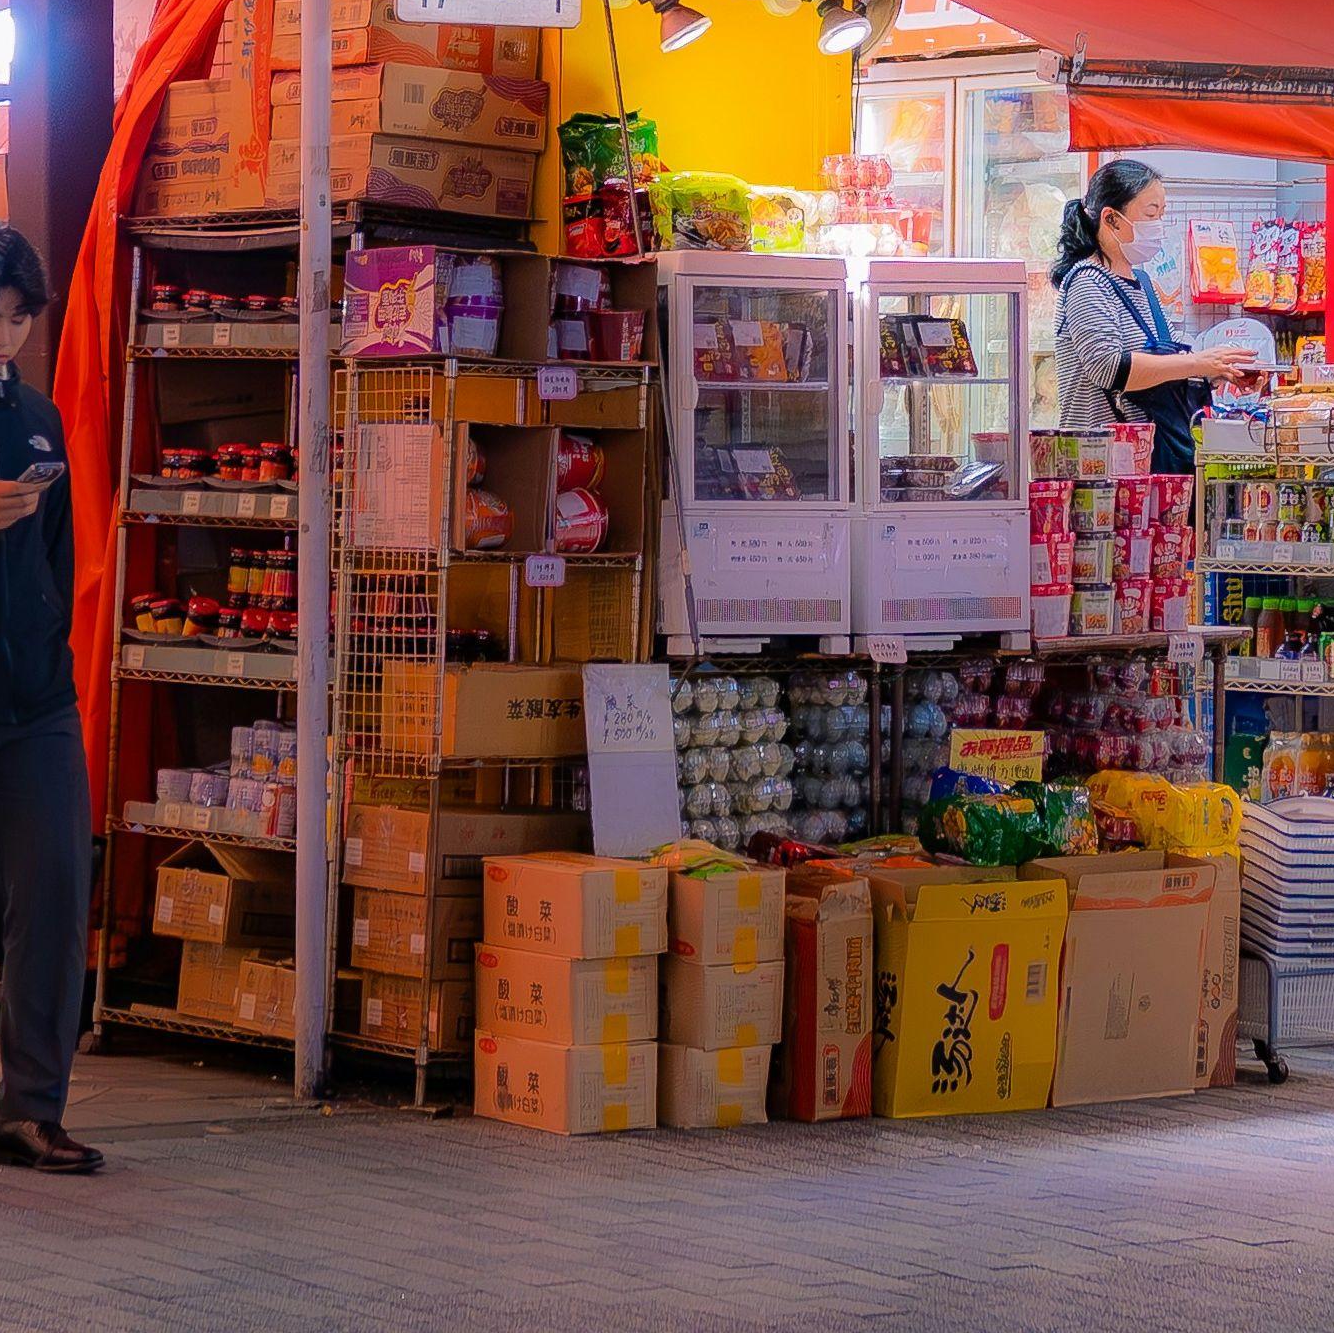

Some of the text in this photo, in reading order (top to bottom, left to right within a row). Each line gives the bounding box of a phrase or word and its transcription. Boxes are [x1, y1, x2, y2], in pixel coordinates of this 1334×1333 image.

[505, 894, 554, 922] 酸菜
[496, 977, 545, 1004] 酸菜
[495, 1063, 542, 1094] 酸菜
